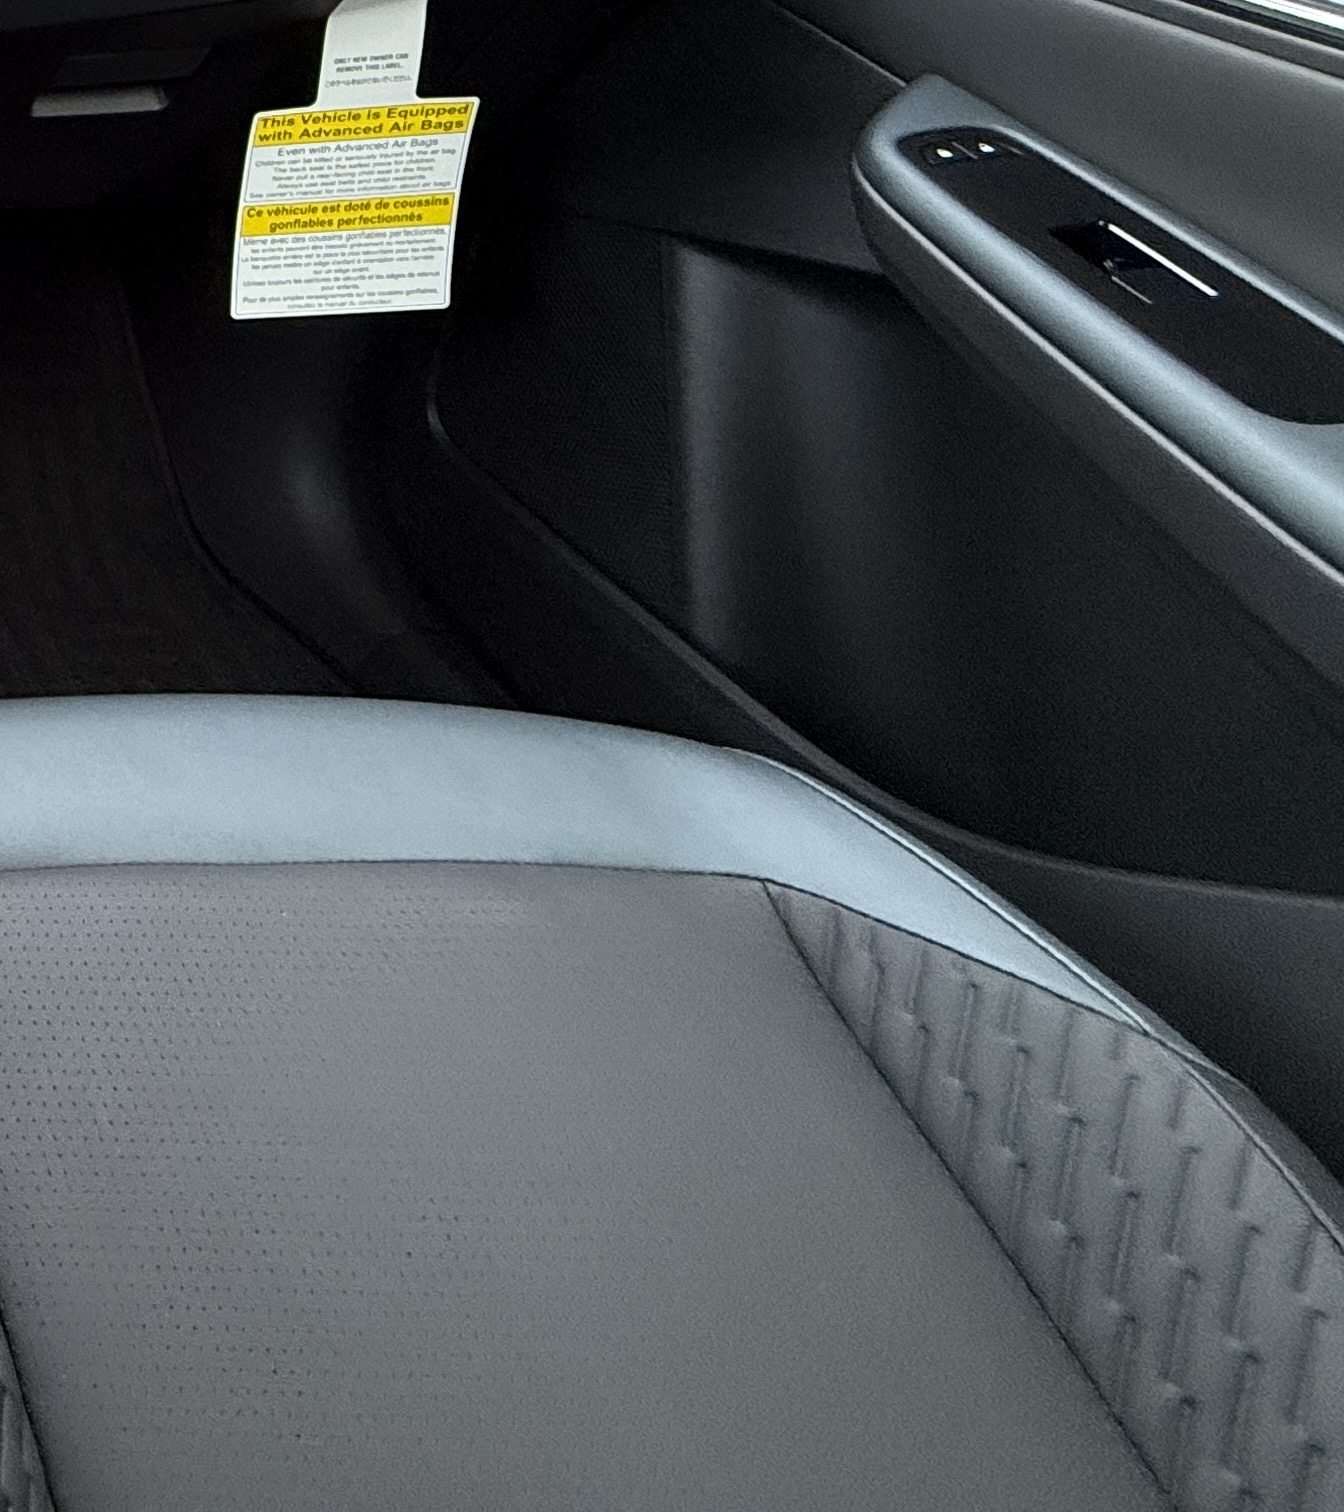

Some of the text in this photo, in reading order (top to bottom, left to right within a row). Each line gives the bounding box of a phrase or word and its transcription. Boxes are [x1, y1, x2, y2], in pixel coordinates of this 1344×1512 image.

[261, 105, 468, 128] This Vehicle is Equipped
[258, 117, 463, 142] with Advanced Air Bags
[277, 137, 438, 156] Even with Advanced Air Bags
[247, 195, 449, 218] Ce véhicule est doté de coussins
[269, 211, 422, 232] gonflables perfectionnés
